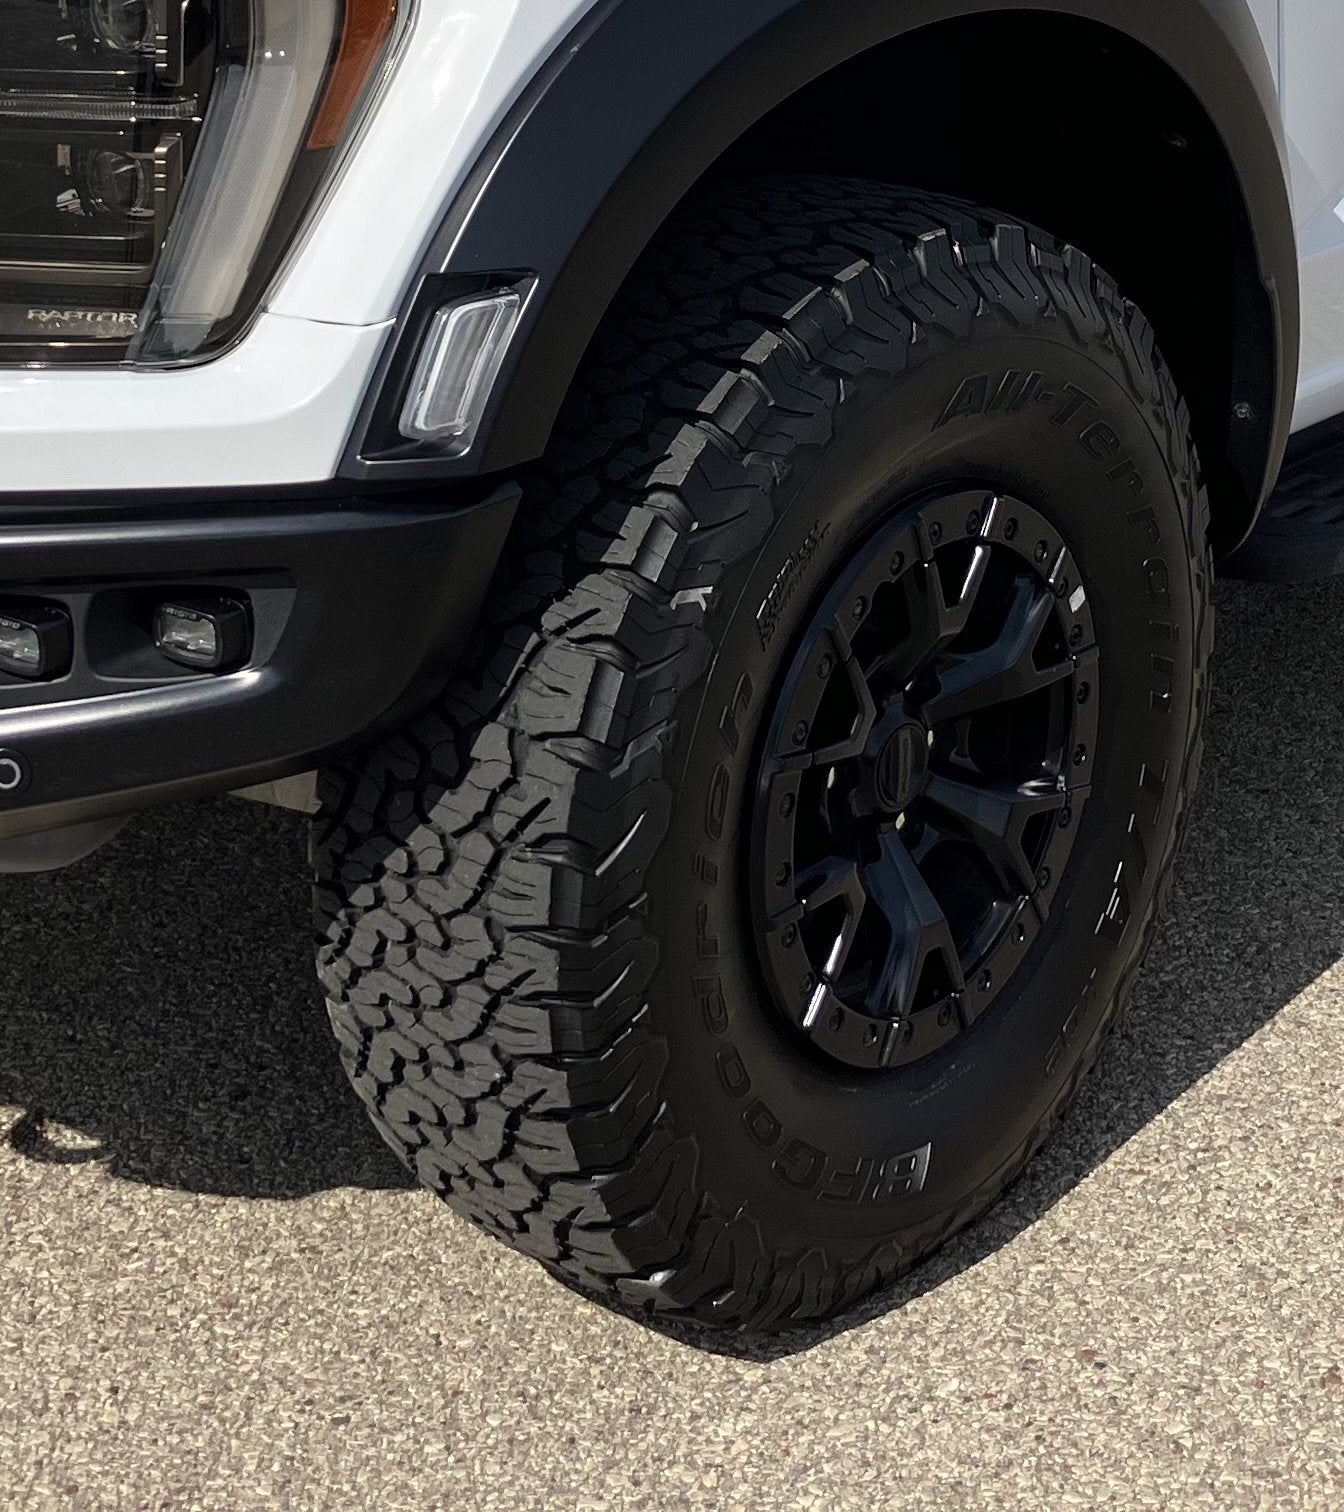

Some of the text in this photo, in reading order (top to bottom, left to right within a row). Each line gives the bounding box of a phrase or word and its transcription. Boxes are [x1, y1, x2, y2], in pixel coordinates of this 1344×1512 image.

[25, 308, 139, 327] RAPTOR
[692, 671, 935, 1205] BFGoodrich
[931, 367, 1181, 715] All-Terrain
